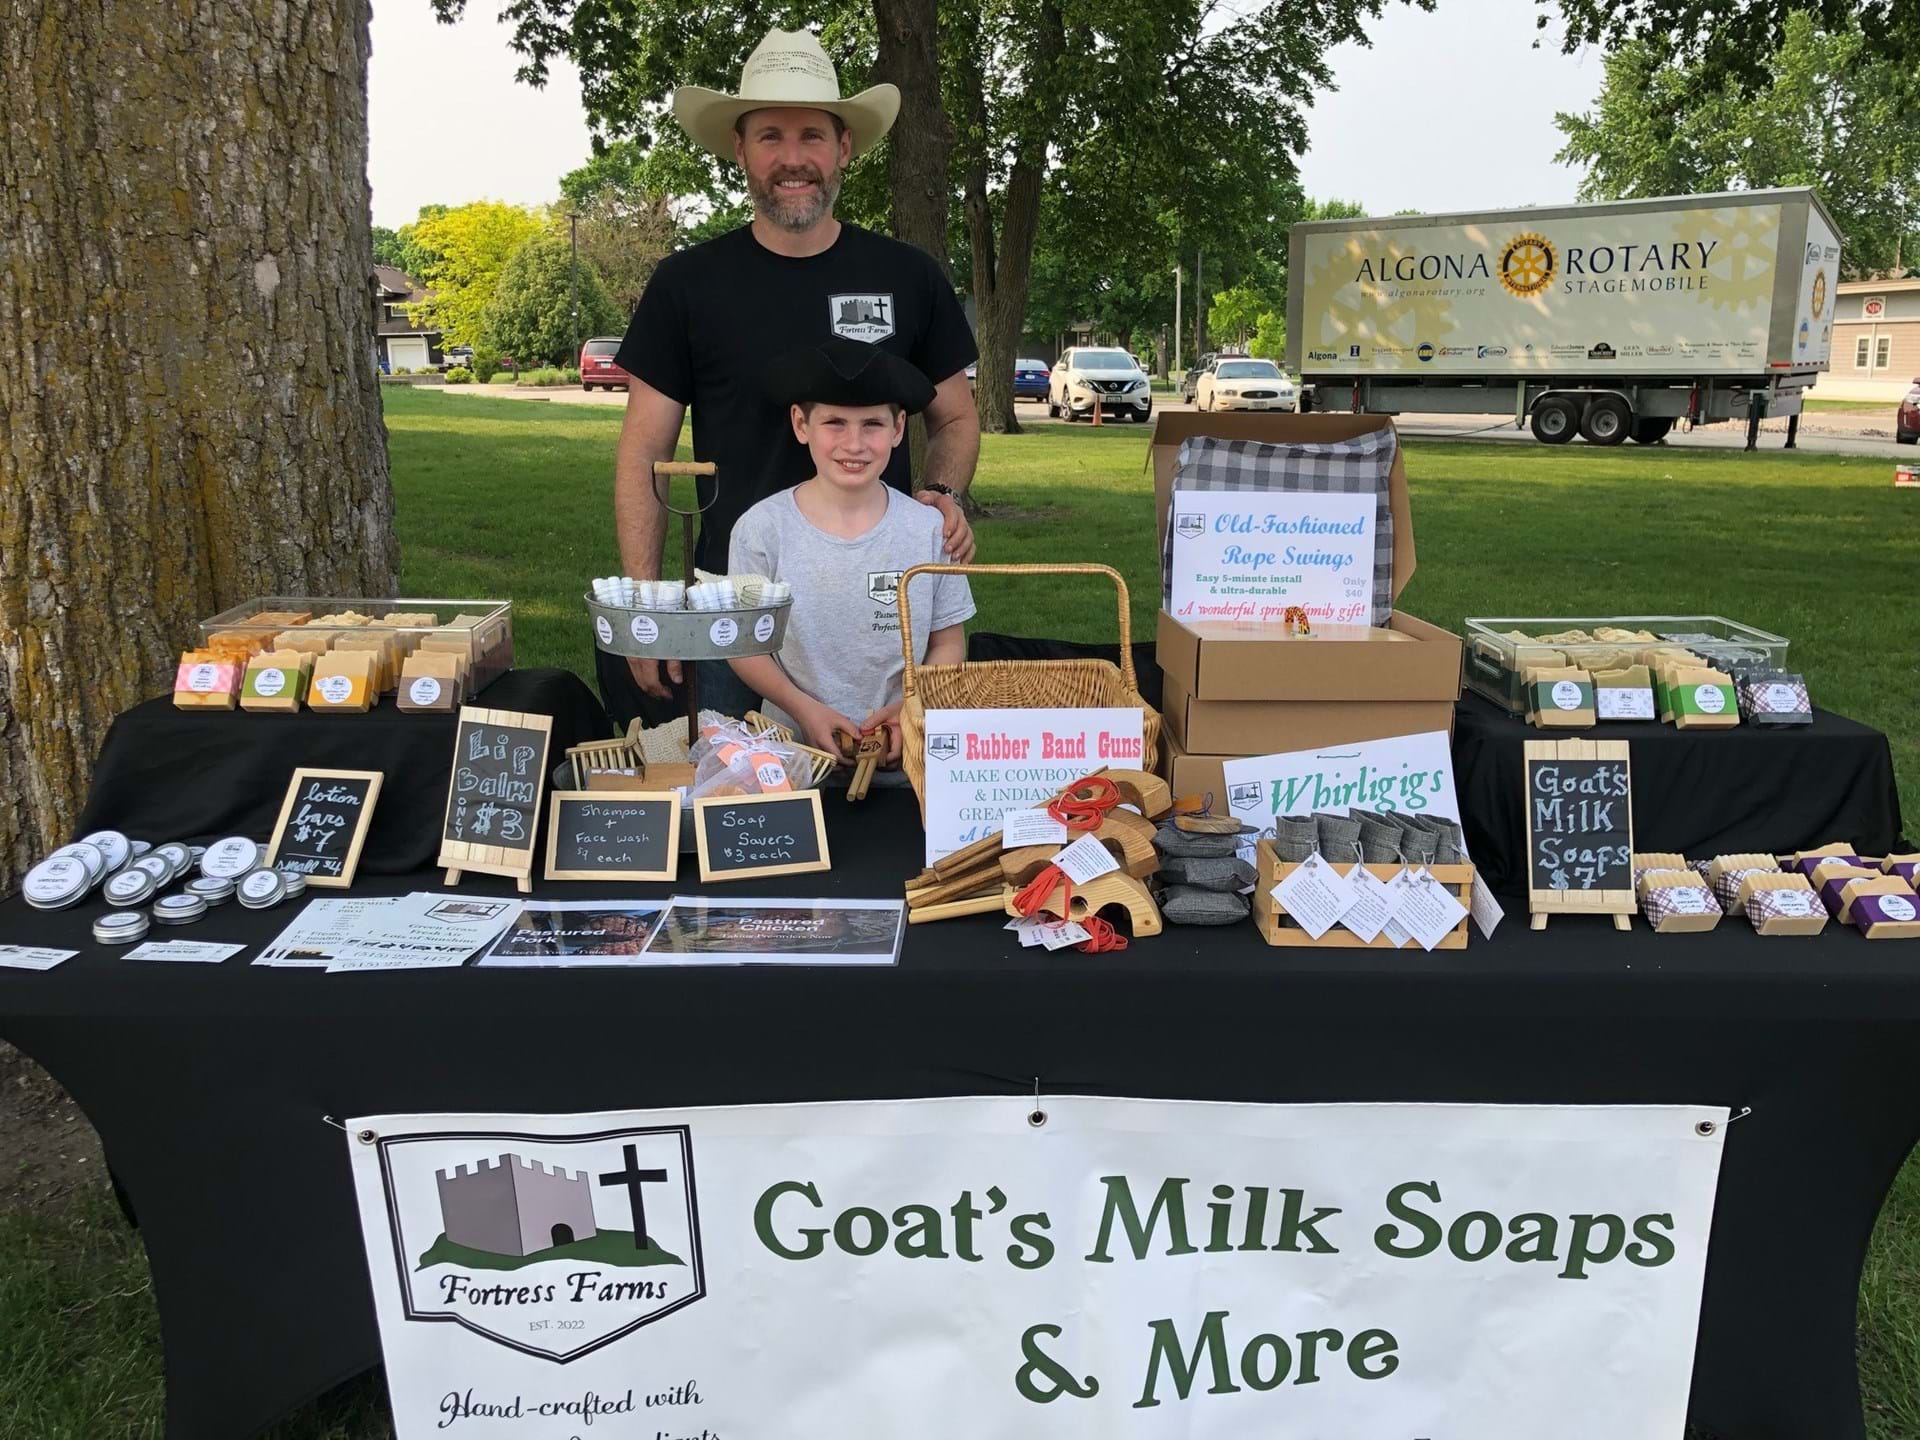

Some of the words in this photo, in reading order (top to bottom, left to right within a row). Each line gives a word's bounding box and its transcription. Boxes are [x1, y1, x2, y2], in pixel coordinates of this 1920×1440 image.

[1356, 253, 1490, 282] ALGONA
[1566, 241, 1718, 275] ROTARY
[1564, 275, 1709, 295] STAGEMOBILE
[839, 326, 866, 334] Fortress
[1308, 351, 1338, 362] Algona
[1215, 513, 1365, 535] Old-Fashioned
[1221, 544, 1276, 571] Rope
[1282, 546, 1354, 572] Swings
[1196, 574, 1219, 584] Easy
[1222, 574, 1268, 583] 5-minute
[1270, 574, 1302, 583] install
[1343, 577, 1367, 588] Only
[1210, 586, 1218, 594] &
[1220, 586, 1287, 595] ultra-durable
[1345, 589, 1363, 598] $40
[1178, 601, 1194, 616] A
[1198, 601, 1257, 621] wonderful
[1339, 602, 1366, 621] gift!
[469, 729, 535, 775] Lip
[966, 733, 1030, 760] Rubber
[1042, 731, 1086, 759] Band
[1098, 731, 1141, 759] Guns
[950, 769, 1000, 783] MAKE
[1005, 768, 1089, 783] COWBOYS
[1535, 765, 1628, 796] Goat's
[303, 782, 361, 805] lotion
[457, 767, 534, 803] Balm
[1270, 763, 1443, 815] Whirligigs
[975, 789, 986, 801] &
[290, 804, 346, 827] bars
[581, 804, 646, 818] Shampoo
[722, 811, 766, 828] Soap
[1534, 798, 1614, 834] Milk
[576, 833, 607, 843] Face
[616, 833, 650, 843] wash
[738, 832, 795, 846] Savers
[960, 826, 977, 842] A
[597, 852, 632, 863] each
[749, 850, 791, 860] each
[1538, 838, 1631, 877] Soaps
[276, 860, 320, 873] small
[1549, 867, 1596, 889] $7
[739, 918, 825, 926] Pastured
[740, 924, 819, 932] Chicken
[510, 936, 558, 944] Pork
[753, 1180, 1055, 1270] Goat’s
[1085, 1174, 1342, 1264] Milk
[1374, 1179, 1675, 1280] Soaps
[439, 1272, 556, 1307] Fortress
[566, 1271, 668, 1303] Farms
[529, 1319, 554, 1332] EST.
[556, 1318, 585, 1331] 2022
[1015, 1323, 1100, 1404] &
[1132, 1310, 1399, 1408] More
[438, 1388, 636, 1429] Hand-crafted
[645, 1379, 704, 1408] with
